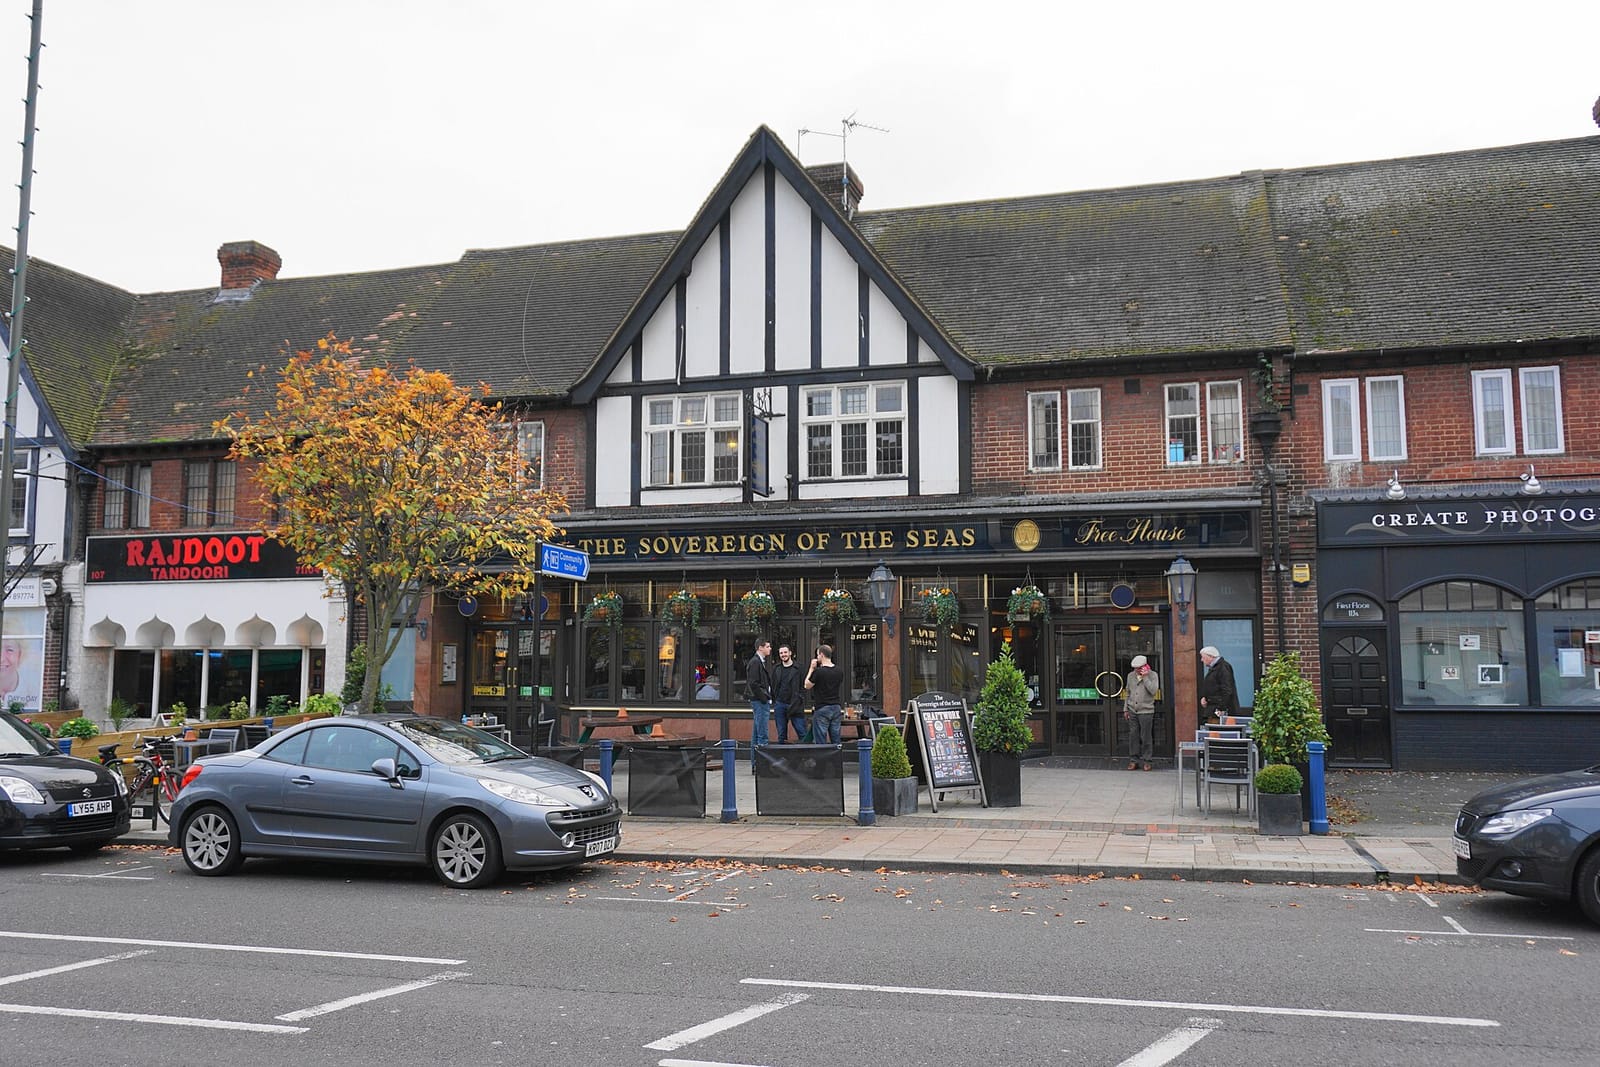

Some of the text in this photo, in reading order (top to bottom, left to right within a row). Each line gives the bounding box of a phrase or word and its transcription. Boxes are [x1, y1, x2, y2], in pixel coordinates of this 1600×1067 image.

[1371, 508, 1600, 527] CREATE PHOTOG
[1075, 517, 1186, 545] Free House
[578, 528, 976, 556] THE SOVEREIGN OF THE SEAS
[126, 536, 265, 566] RAJDOOT
[559, 551, 583, 566] Community
[91, 570, 105, 580] 107
[150, 565, 229, 580] TANDOORI
[563, 562, 578, 573] toilets
[923, 711, 960, 720] CRAFTWORK
[73, 801, 111, 814] LY55 AHP
